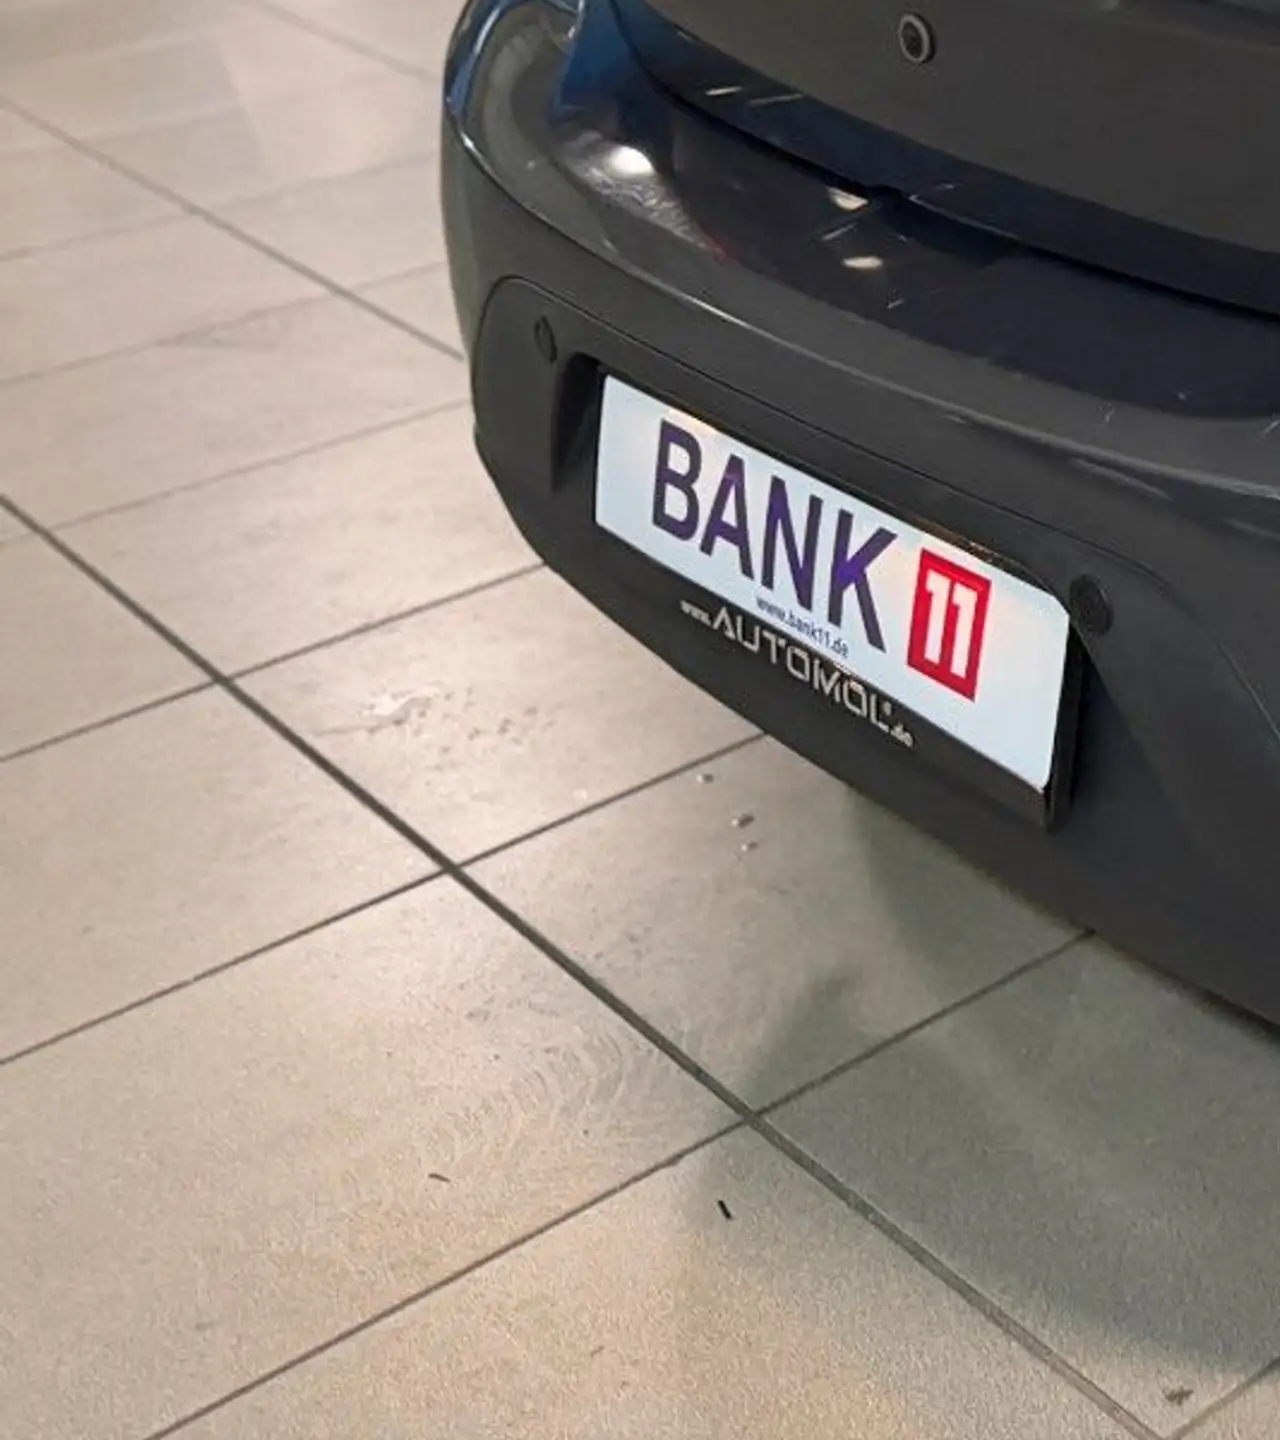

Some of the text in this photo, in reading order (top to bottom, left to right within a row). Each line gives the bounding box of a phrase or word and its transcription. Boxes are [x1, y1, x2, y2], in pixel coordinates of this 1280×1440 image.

[652, 418, 981, 681] BANK 11
[755, 596, 849, 660] www.bank11.de
